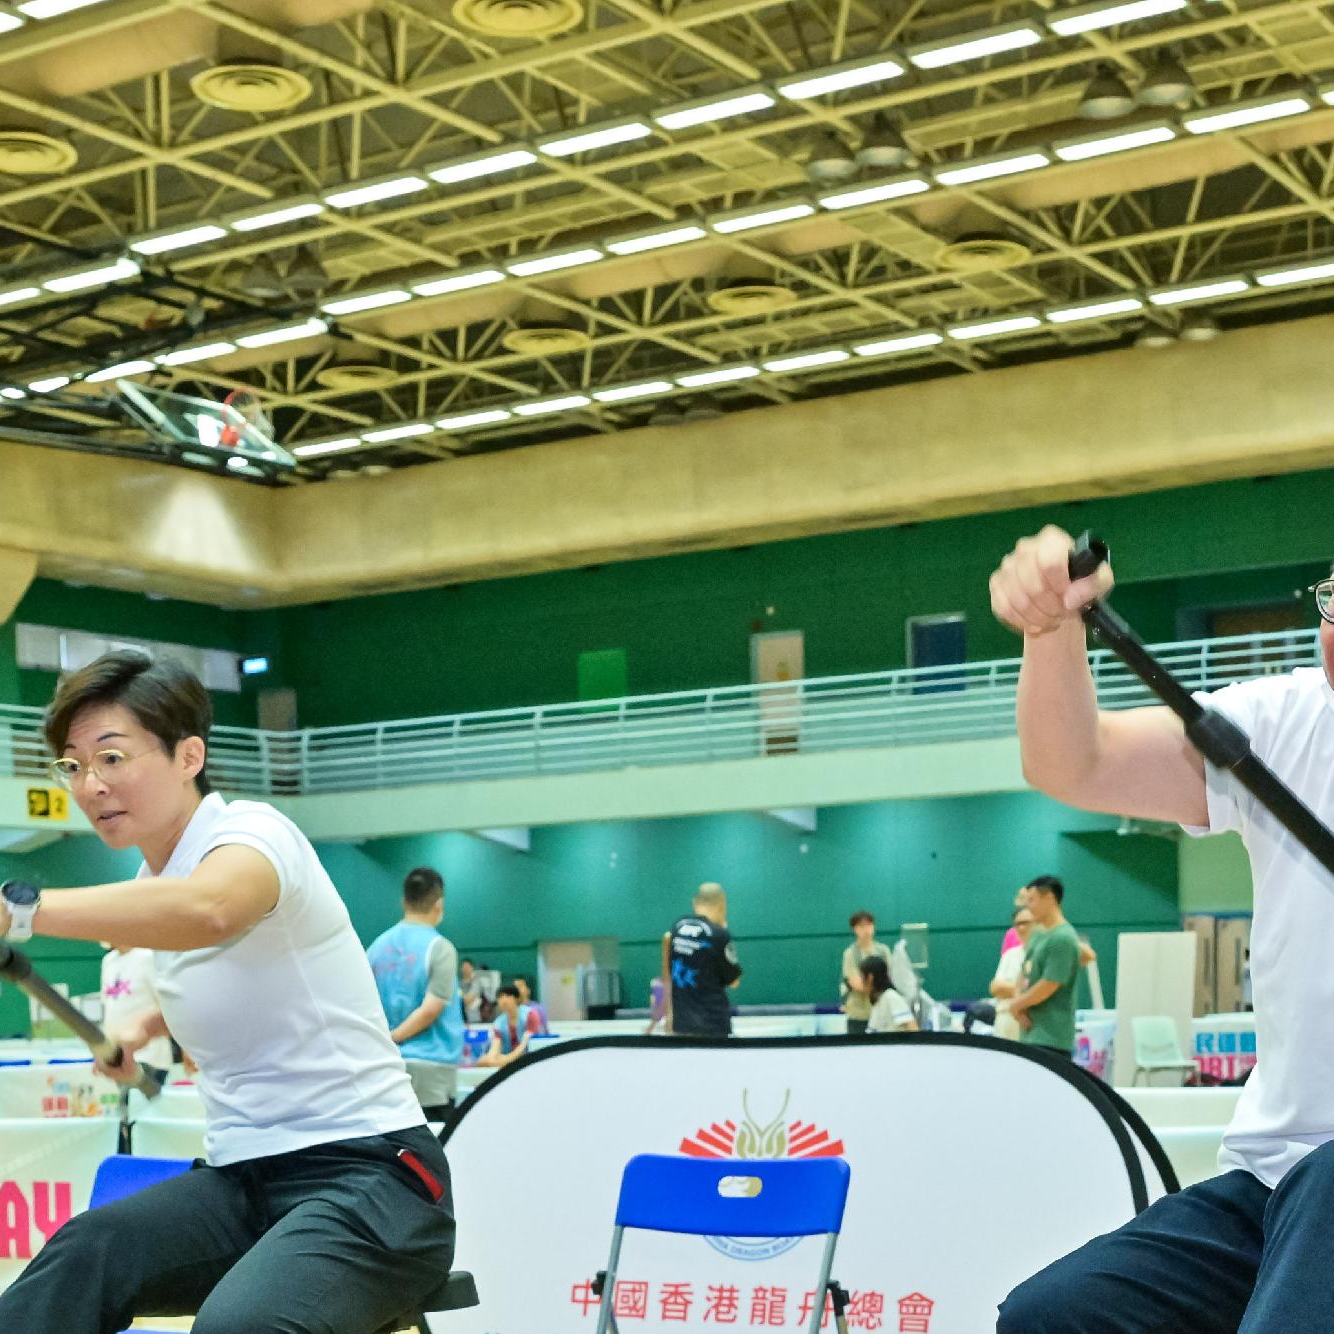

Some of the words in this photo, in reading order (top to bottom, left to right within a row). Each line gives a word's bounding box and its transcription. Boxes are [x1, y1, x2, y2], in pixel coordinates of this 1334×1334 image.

[54, 799, 65, 813] 2
[571, 1278, 934, 1334] 中國香港龍舟總會
